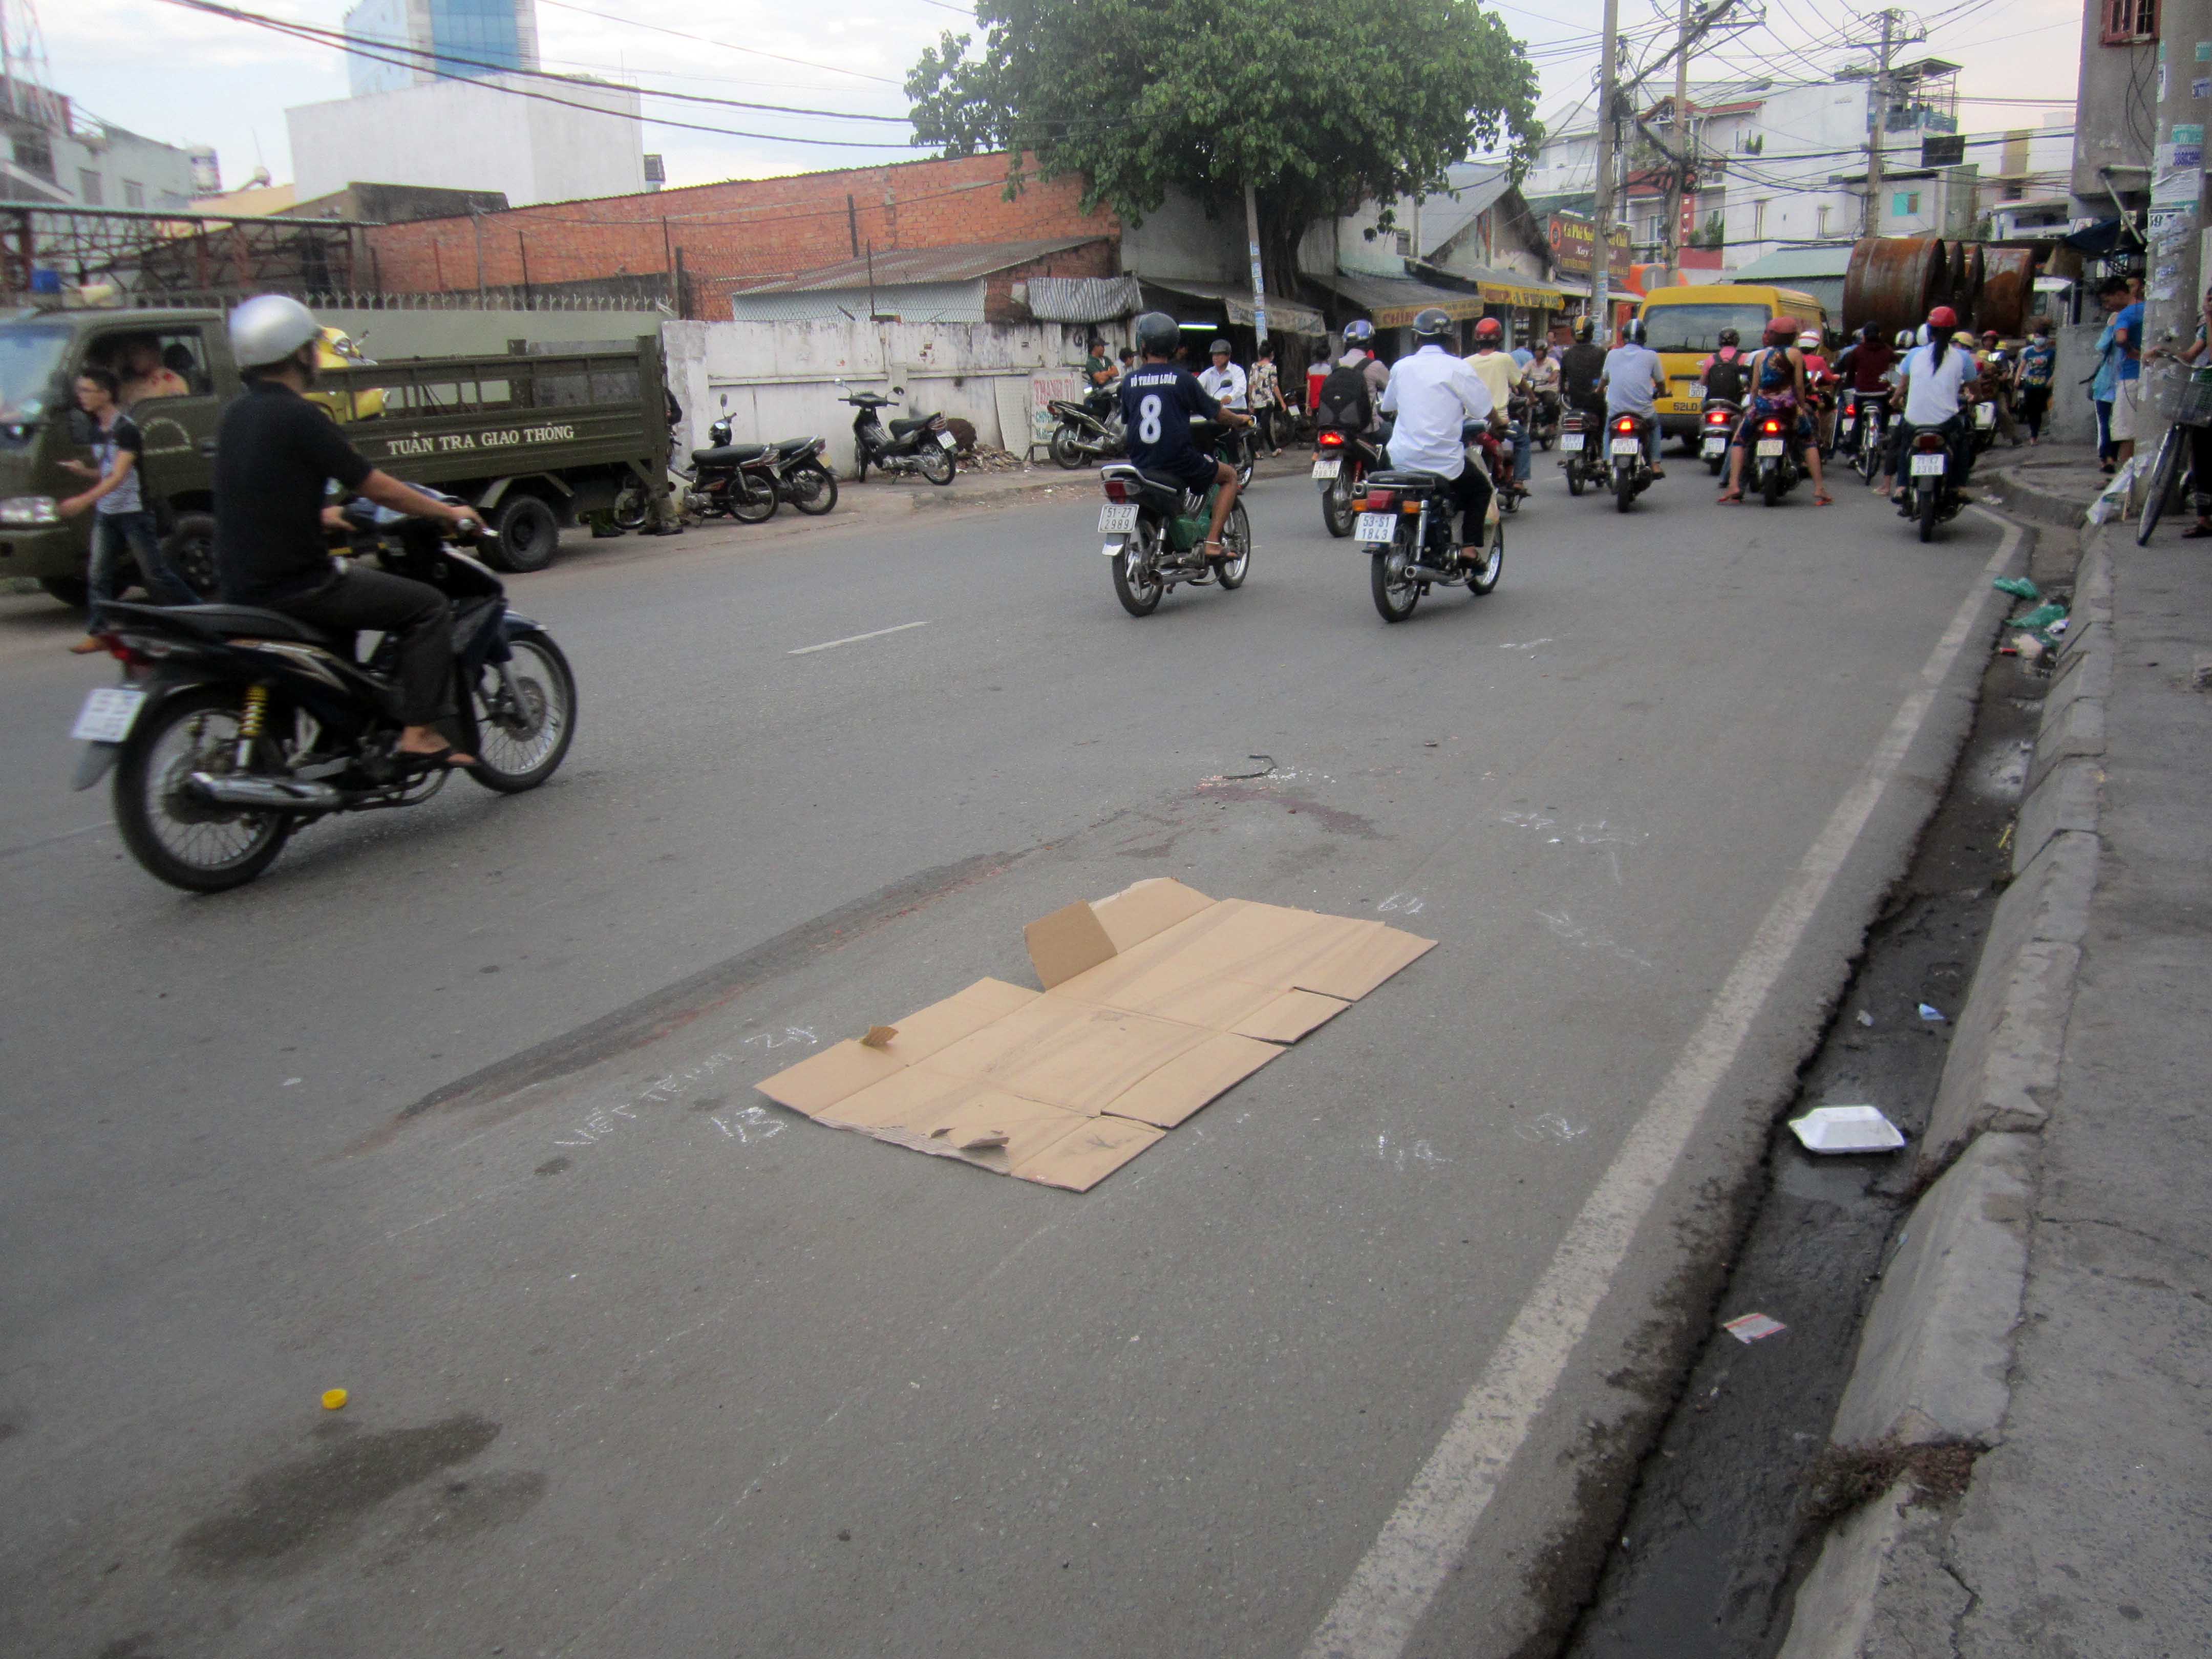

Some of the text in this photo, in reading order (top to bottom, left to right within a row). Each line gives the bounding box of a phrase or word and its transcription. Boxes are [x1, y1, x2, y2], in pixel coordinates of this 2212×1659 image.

[1139, 394, 1162, 443] 8
[387, 422, 574, 455] TUẦN TRA GIAO THÔNG
[1107, 507, 1132, 518] 51-Z7
[1104, 519, 1130, 529] 2989
[1363, 515, 1390, 528] 53-S1
[1362, 528, 1388, 540] 1843
